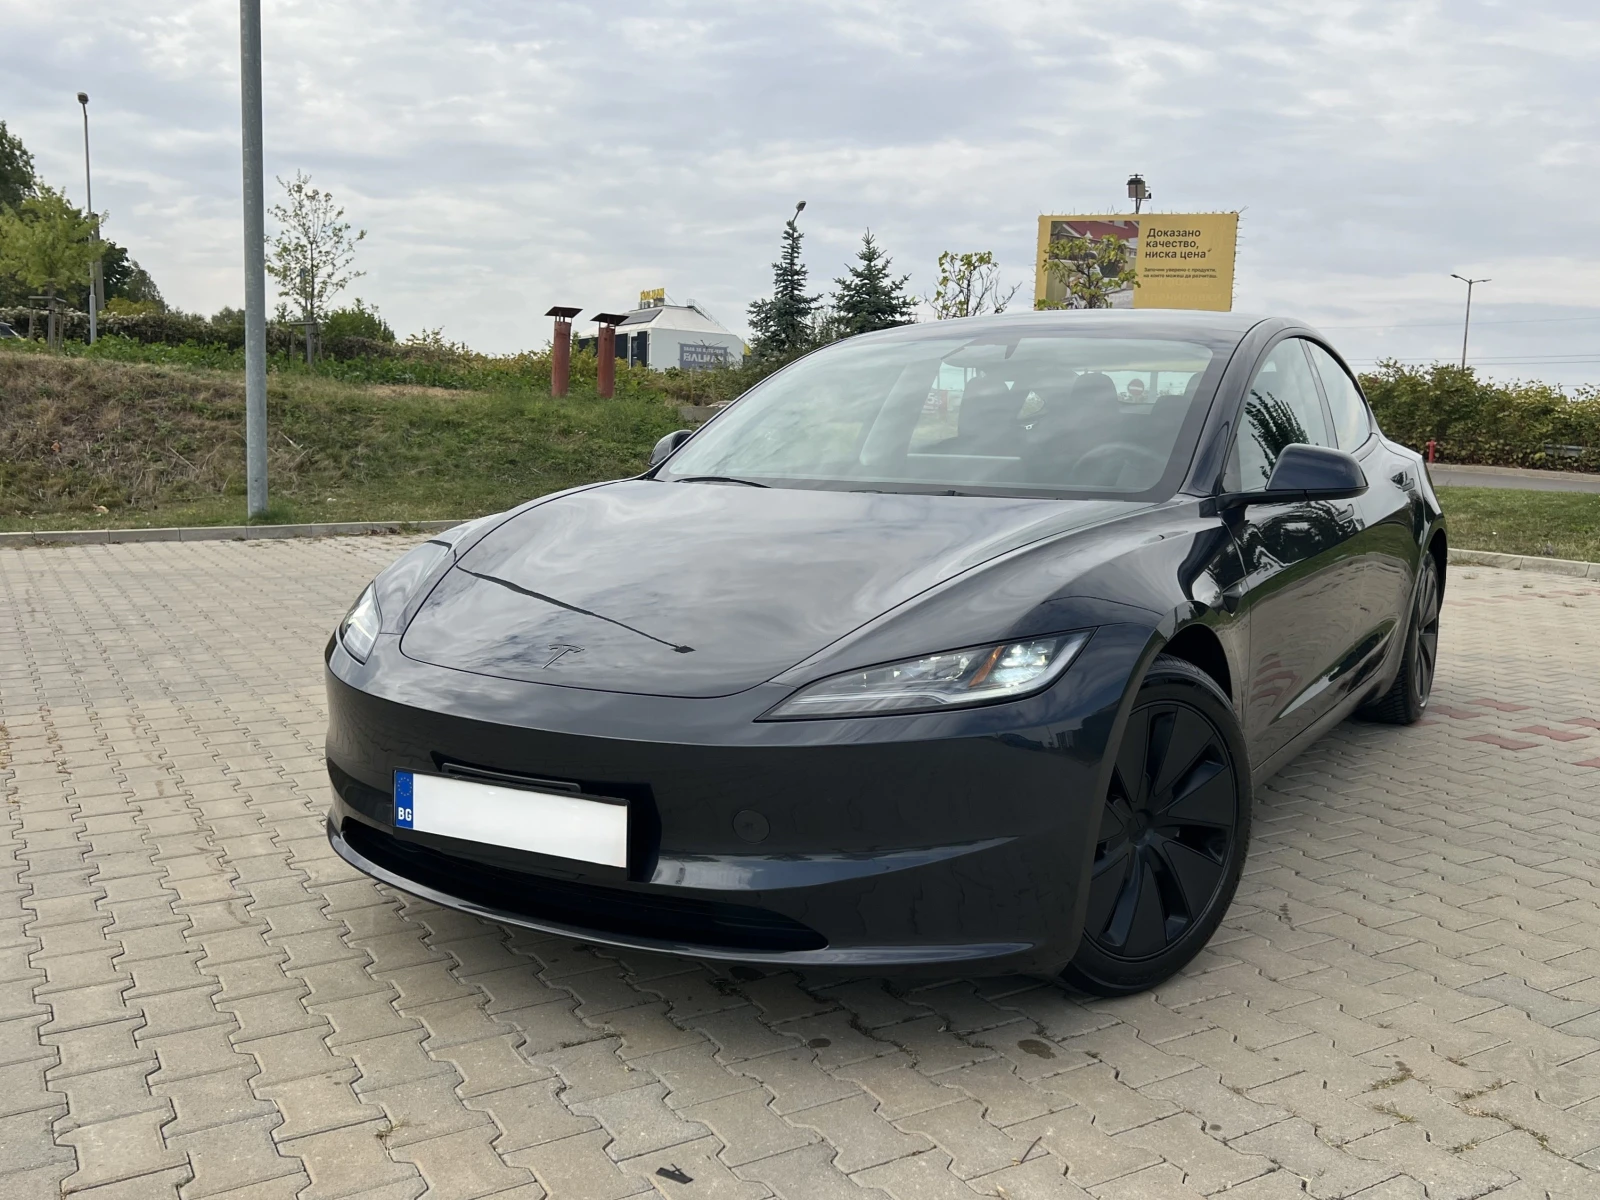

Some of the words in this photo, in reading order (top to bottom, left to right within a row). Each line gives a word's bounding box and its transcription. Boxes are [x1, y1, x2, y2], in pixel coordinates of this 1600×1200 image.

[1146, 228, 1201, 239] Доказано
[1145, 240, 1199, 249] качество,
[1144, 251, 1177, 259] ниска
[1180, 251, 1206, 260] цена
[398, 807, 413, 821] BG
